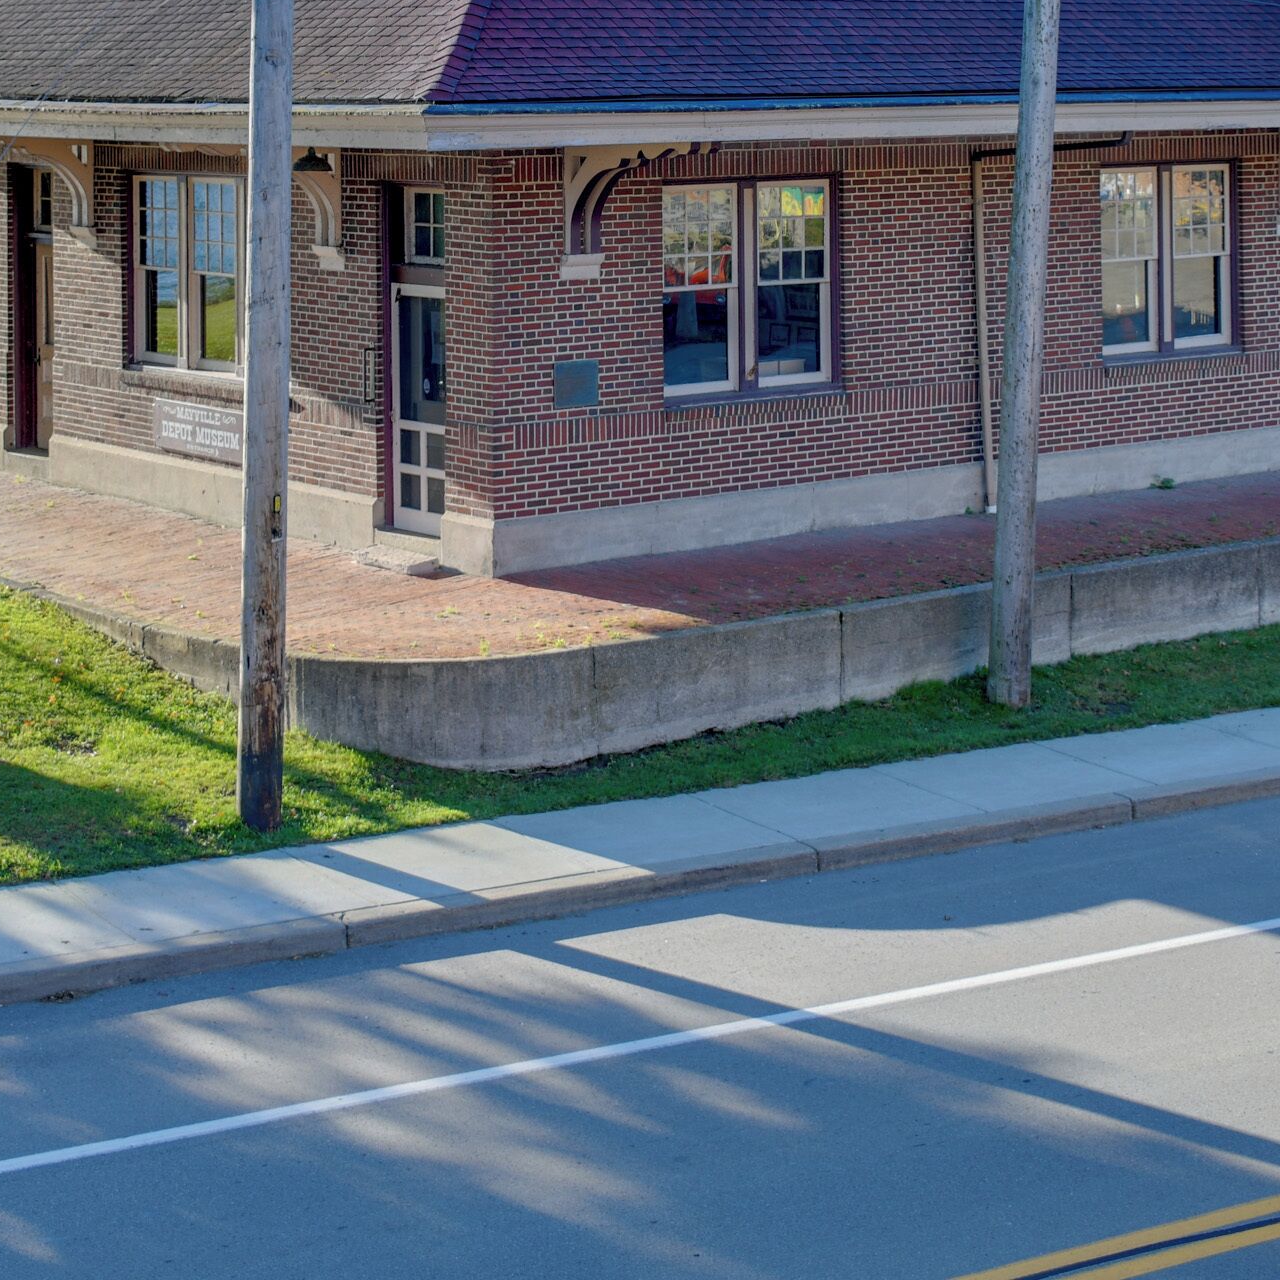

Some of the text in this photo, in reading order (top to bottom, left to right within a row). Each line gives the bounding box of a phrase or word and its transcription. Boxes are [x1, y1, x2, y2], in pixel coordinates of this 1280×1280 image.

[177, 406, 221, 426] MAYVILLE
[161, 420, 240, 450] DEPOT MUSEUM
